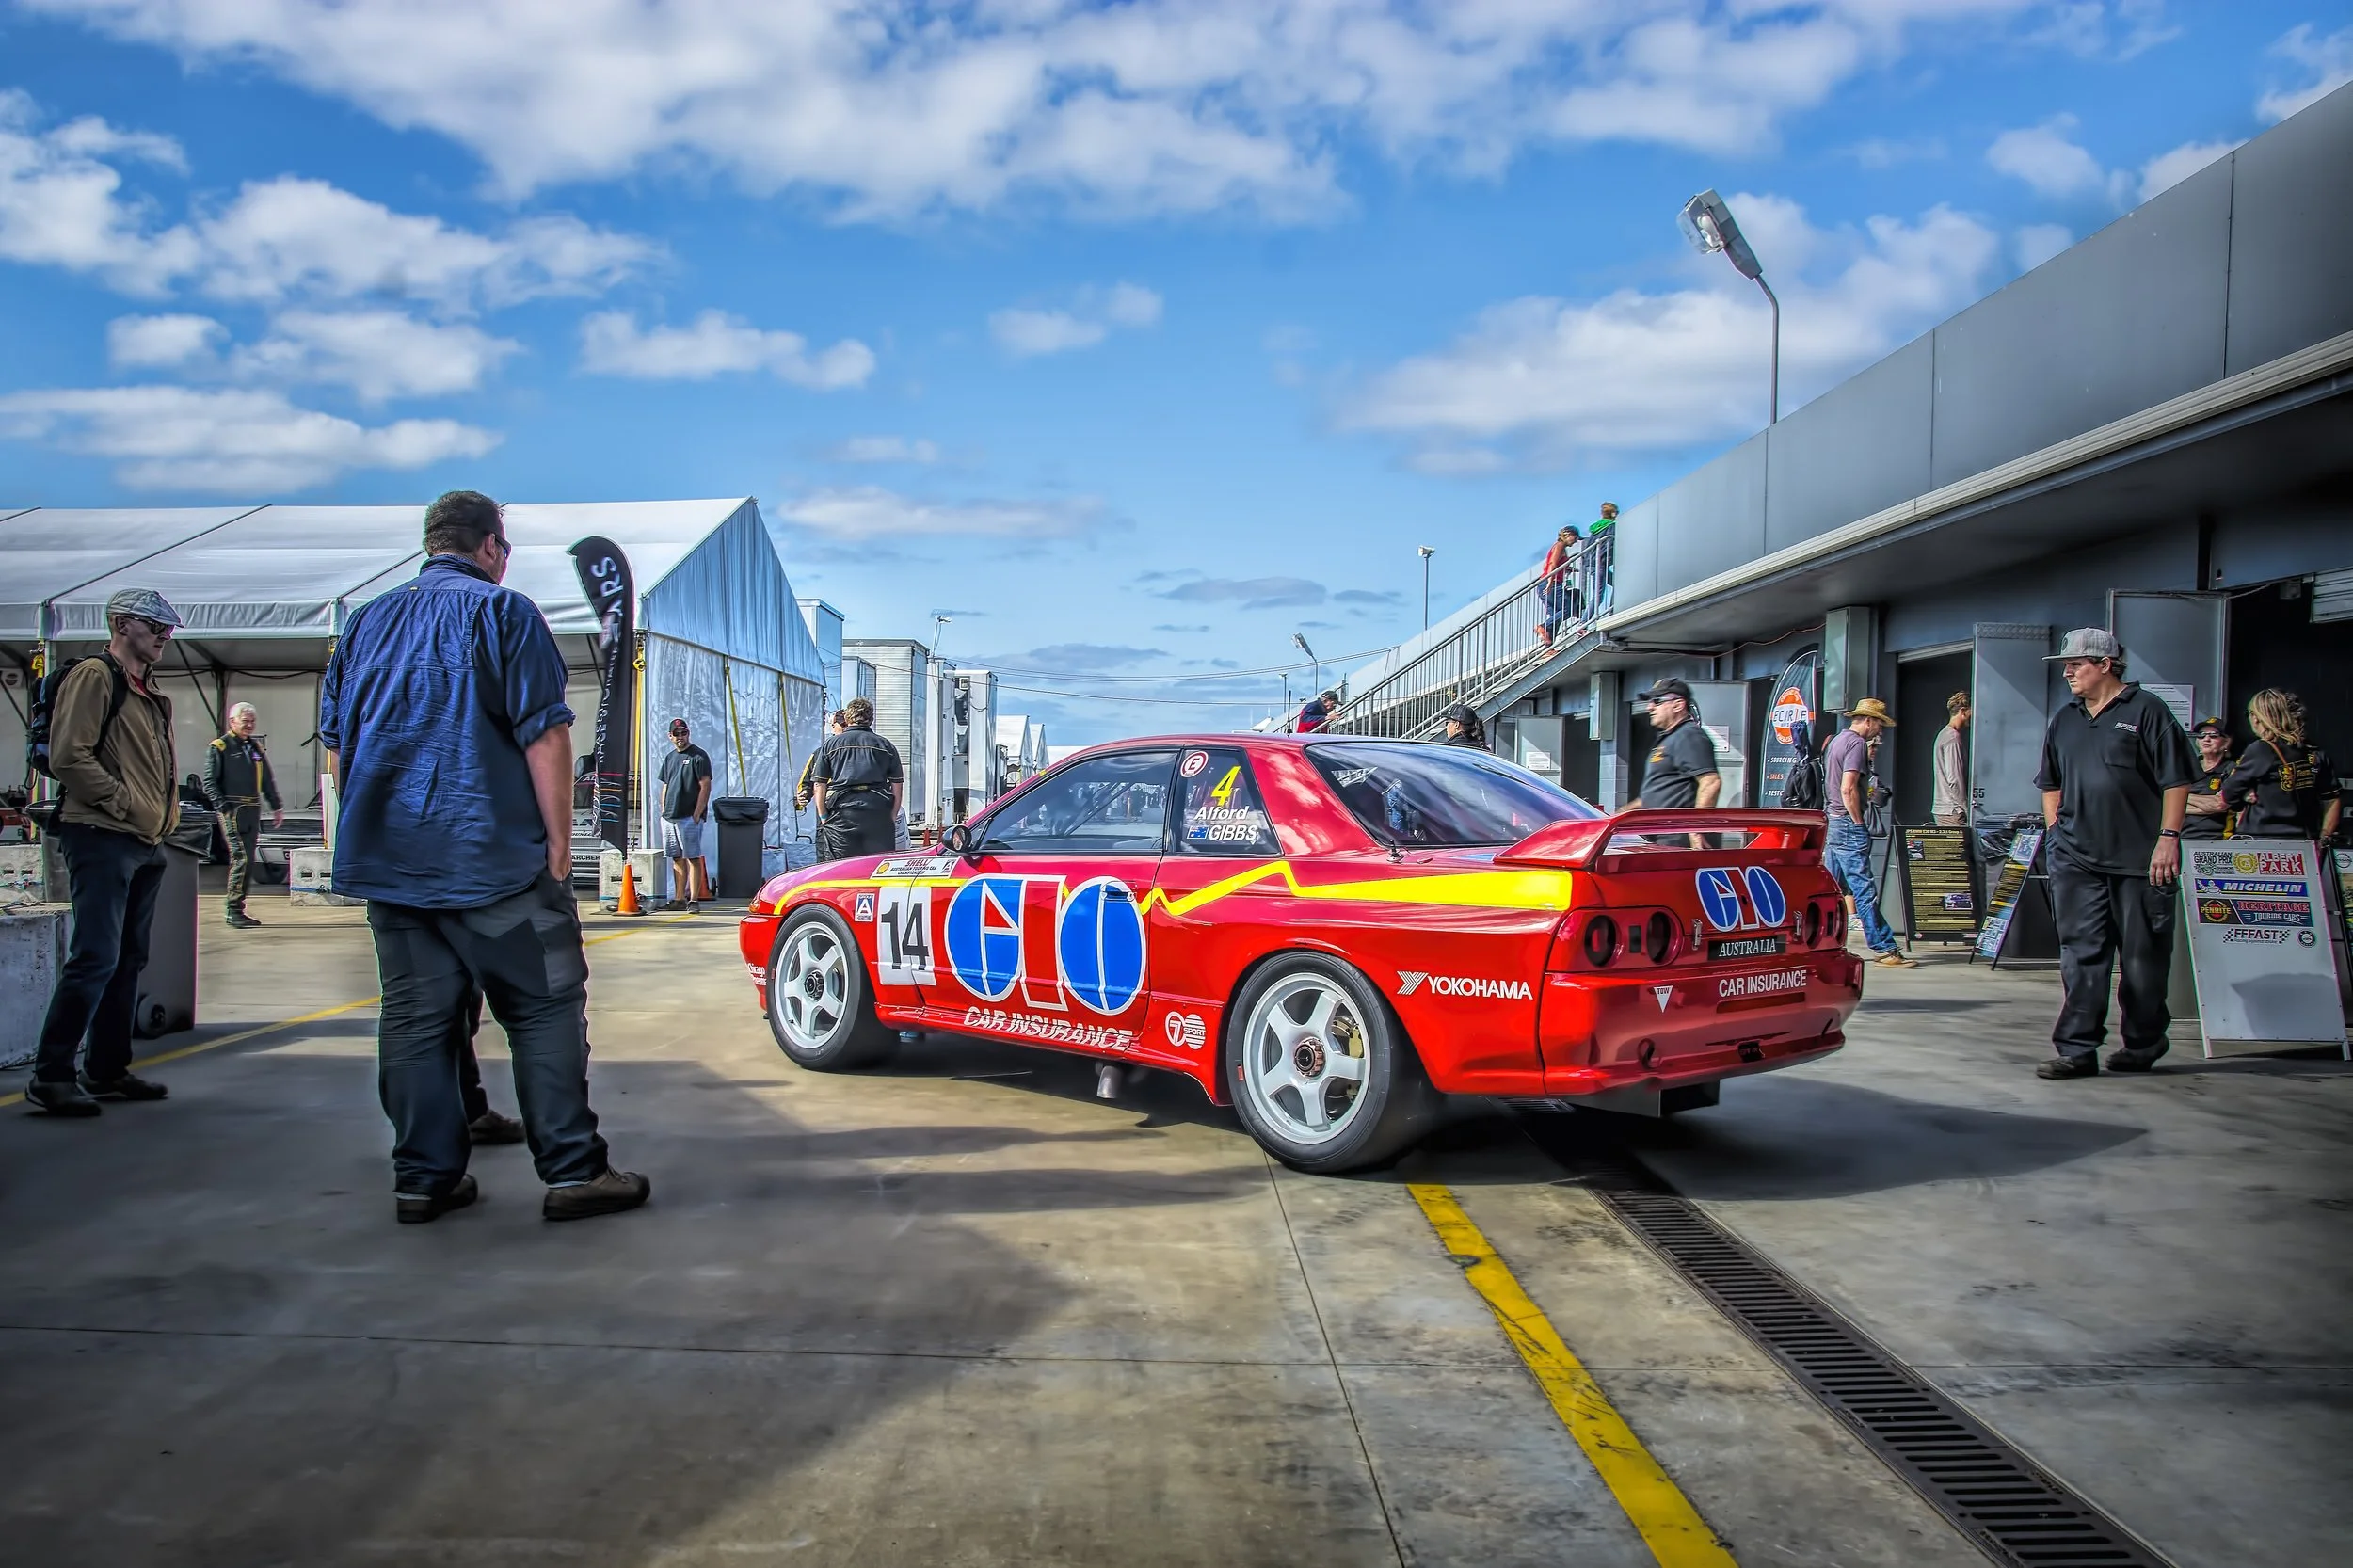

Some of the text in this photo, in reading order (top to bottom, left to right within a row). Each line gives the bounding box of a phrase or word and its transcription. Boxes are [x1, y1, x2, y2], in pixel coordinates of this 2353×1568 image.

[1210, 765, 1241, 807] 4
[1194, 806, 1250, 821] Alford
[1209, 824, 1258, 841] GIBBS
[904, 858, 929, 867] SHELL
[2194, 856, 2217, 864] GRAND
[2259, 851, 2302, 862] ALBERT
[2260, 861, 2302, 872] PARK
[2222, 882, 2302, 893] MICHELIN
[856, 898, 872, 914] A
[1695, 865, 1786, 932] GIO
[2200, 906, 2232, 915] PENRITE
[2237, 900, 2310, 913] HERITAGE
[2254, 912, 2282, 920] TOURING
[2283, 913, 2300, 922] CARS
[881, 901, 930, 971] 14
[944, 873, 1147, 1016] GIO
[1719, 938, 1777, 957] AUSTRALIA
[1427, 975, 1533, 1000] YOKOHAMA
[1719, 970, 1807, 998] CAR INSURANCE
[964, 1006, 1133, 1051] CAR INSURANCE
[1183, 1027, 1207, 1036] SPORT
